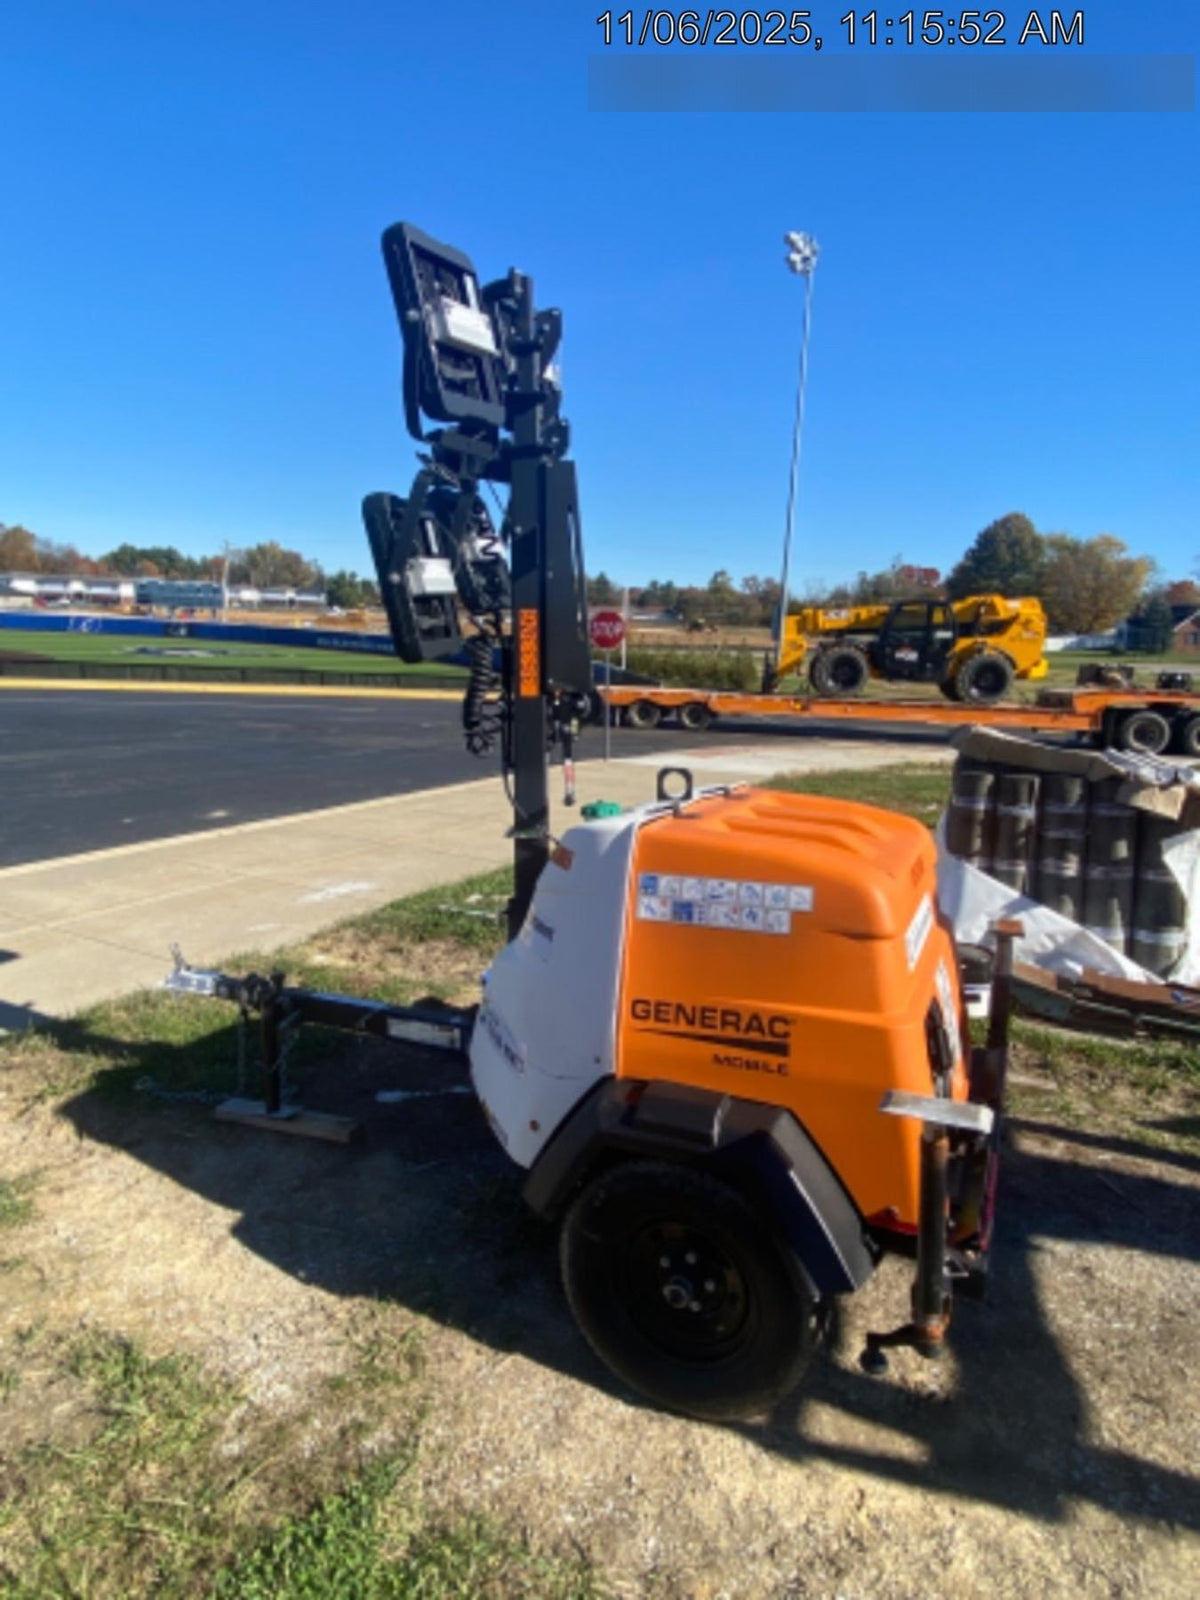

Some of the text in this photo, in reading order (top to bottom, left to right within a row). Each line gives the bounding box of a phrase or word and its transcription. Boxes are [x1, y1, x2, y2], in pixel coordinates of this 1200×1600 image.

[593, 620, 622, 637] STOP
[631, 999, 792, 1040] GENERAC
[712, 1053, 789, 1077] MOBILE
